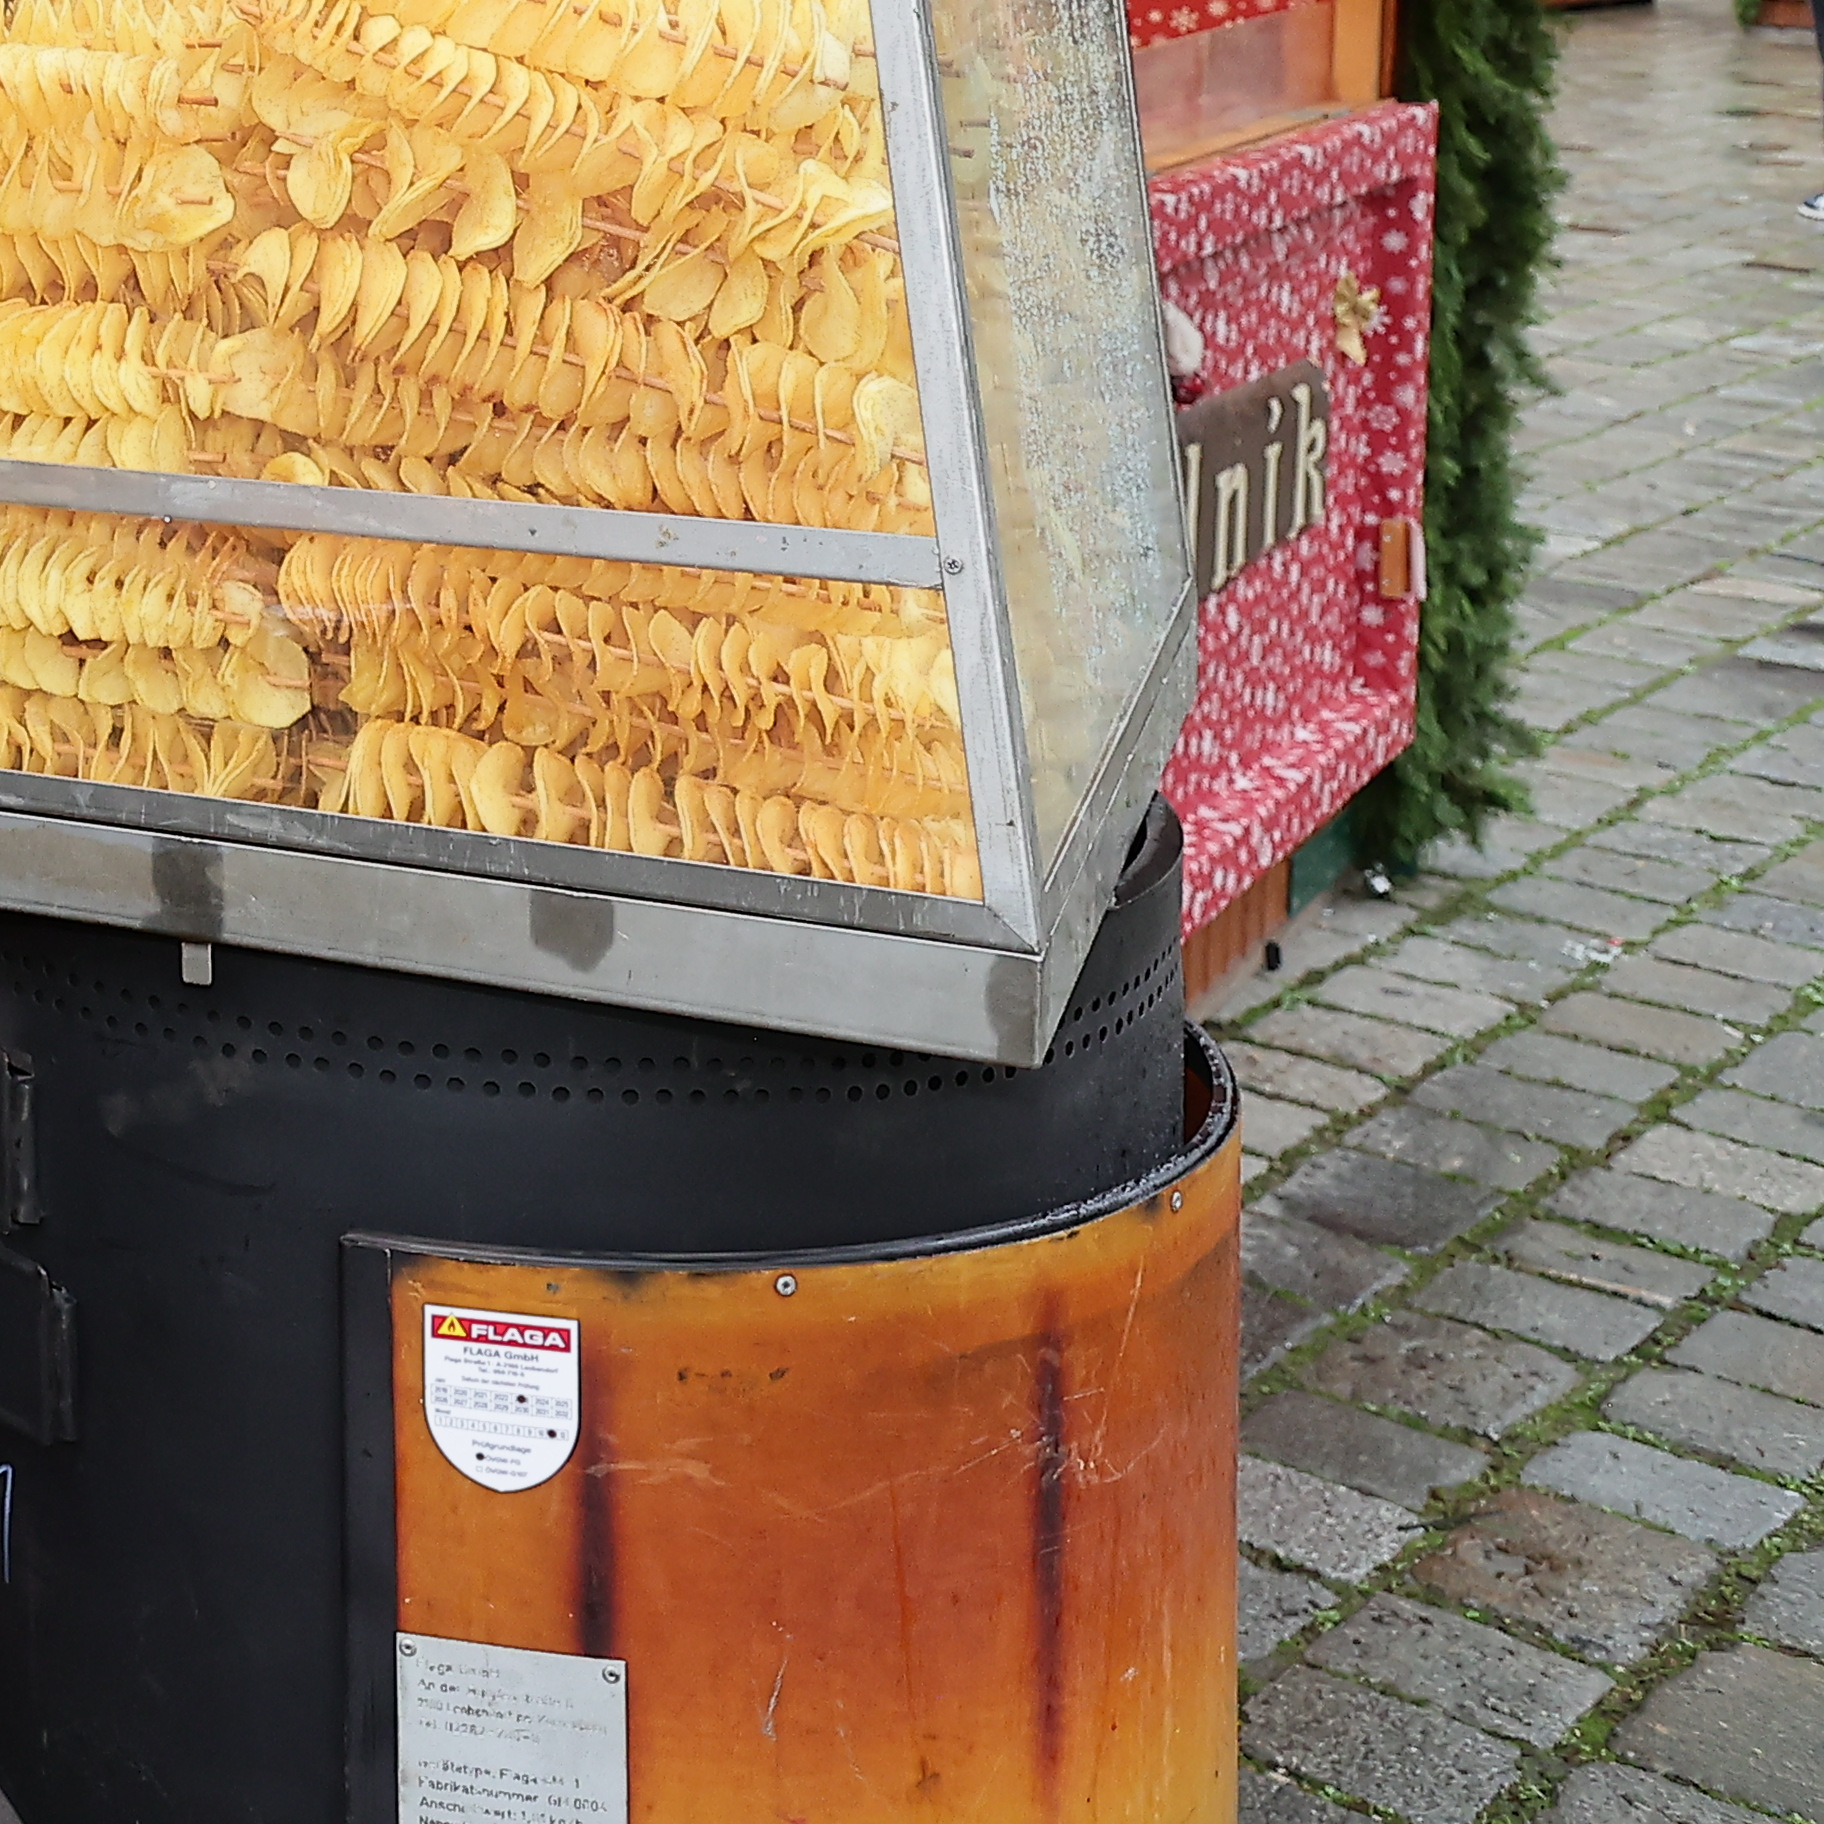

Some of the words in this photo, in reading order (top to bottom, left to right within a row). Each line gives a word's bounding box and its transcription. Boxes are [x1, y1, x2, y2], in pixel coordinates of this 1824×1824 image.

[470, 1323, 566, 1348] FLAGA
[463, 1346, 501, 1358] FLAGA
[504, 1350, 539, 1362] GmbH
